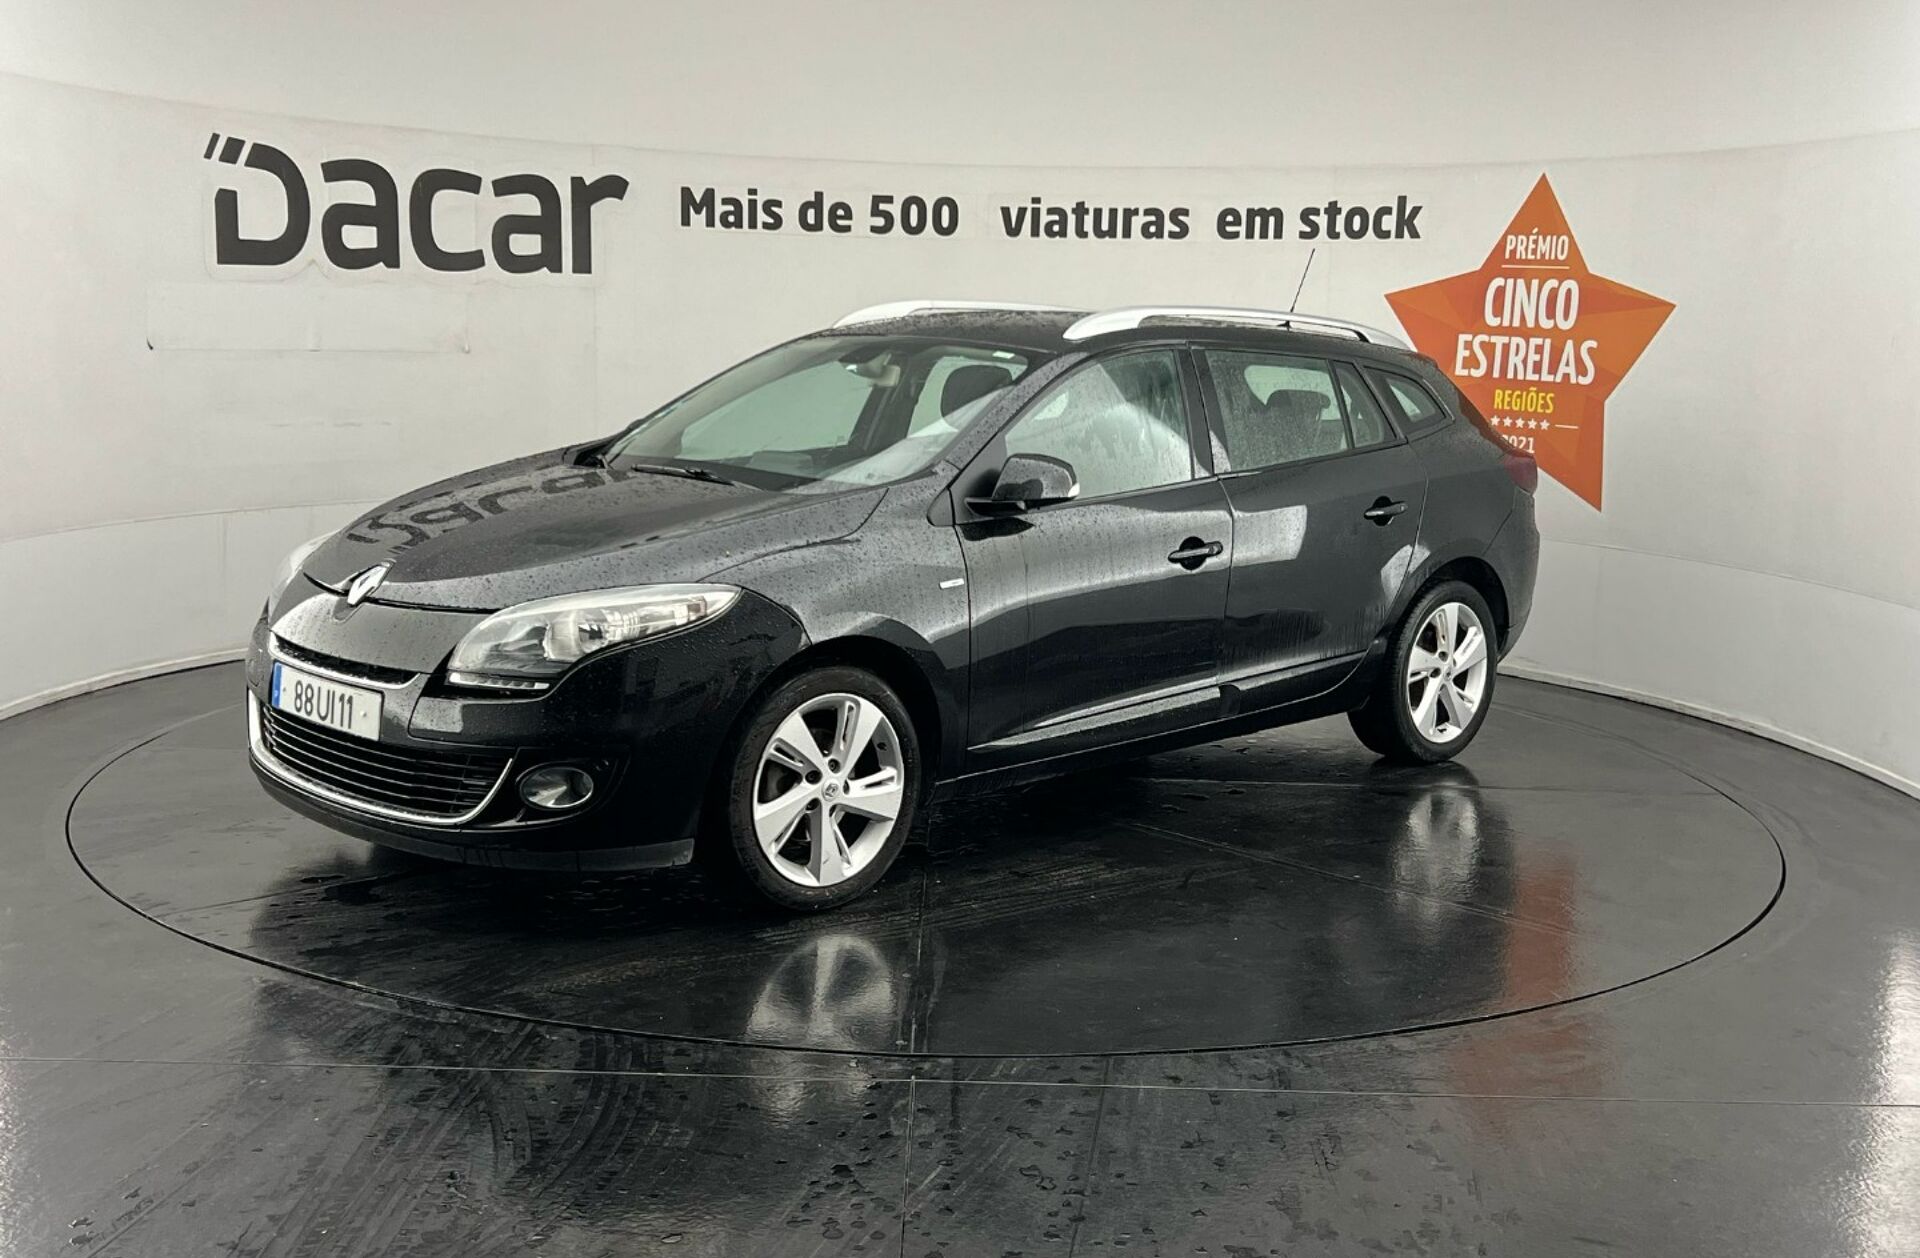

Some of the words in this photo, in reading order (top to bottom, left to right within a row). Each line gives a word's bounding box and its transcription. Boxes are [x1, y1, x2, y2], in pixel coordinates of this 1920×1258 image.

[204, 133, 630, 275] Dacar
[680, 186, 784, 230] Mais
[798, 190, 853, 233] de
[869, 194, 959, 236] 500
[1000, 196, 1190, 239] viaturas
[1216, 206, 1284, 240] em
[1299, 194, 1423, 240] stock
[1504, 227, 1569, 261] PRÉMIO
[1484, 276, 1580, 331] CINCO
[1454, 333, 1598, 386] ESTRELAS
[1493, 386, 1555, 414] REGIÕES
